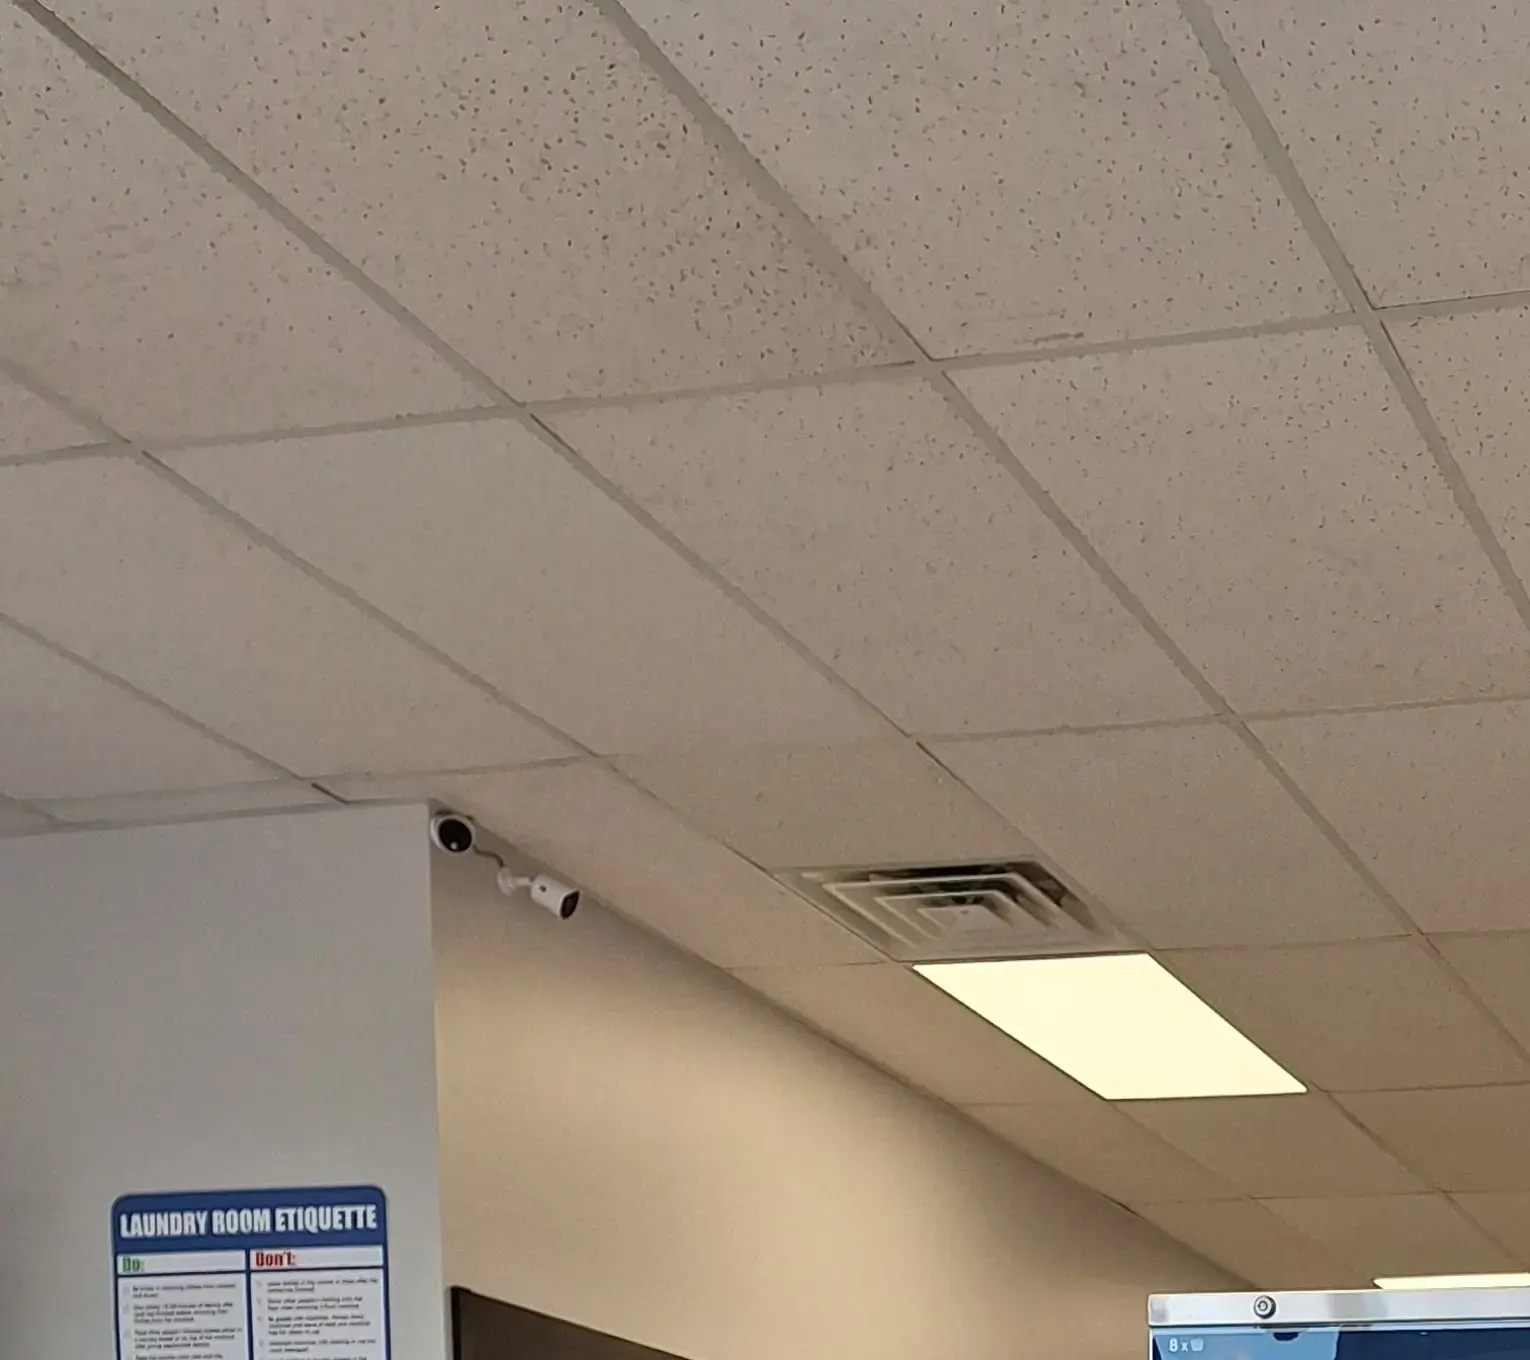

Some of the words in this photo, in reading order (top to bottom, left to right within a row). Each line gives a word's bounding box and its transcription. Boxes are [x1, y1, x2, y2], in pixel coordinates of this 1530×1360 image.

[120, 1210, 208, 1239] LAUNDRY
[212, 1207, 271, 1235] ROOM
[275, 1204, 378, 1233] ETIQUETTE
[122, 1255, 146, 1273] Do:
[255, 1250, 297, 1268] Don't:
[1169, 1338, 1178, 1353] 8
